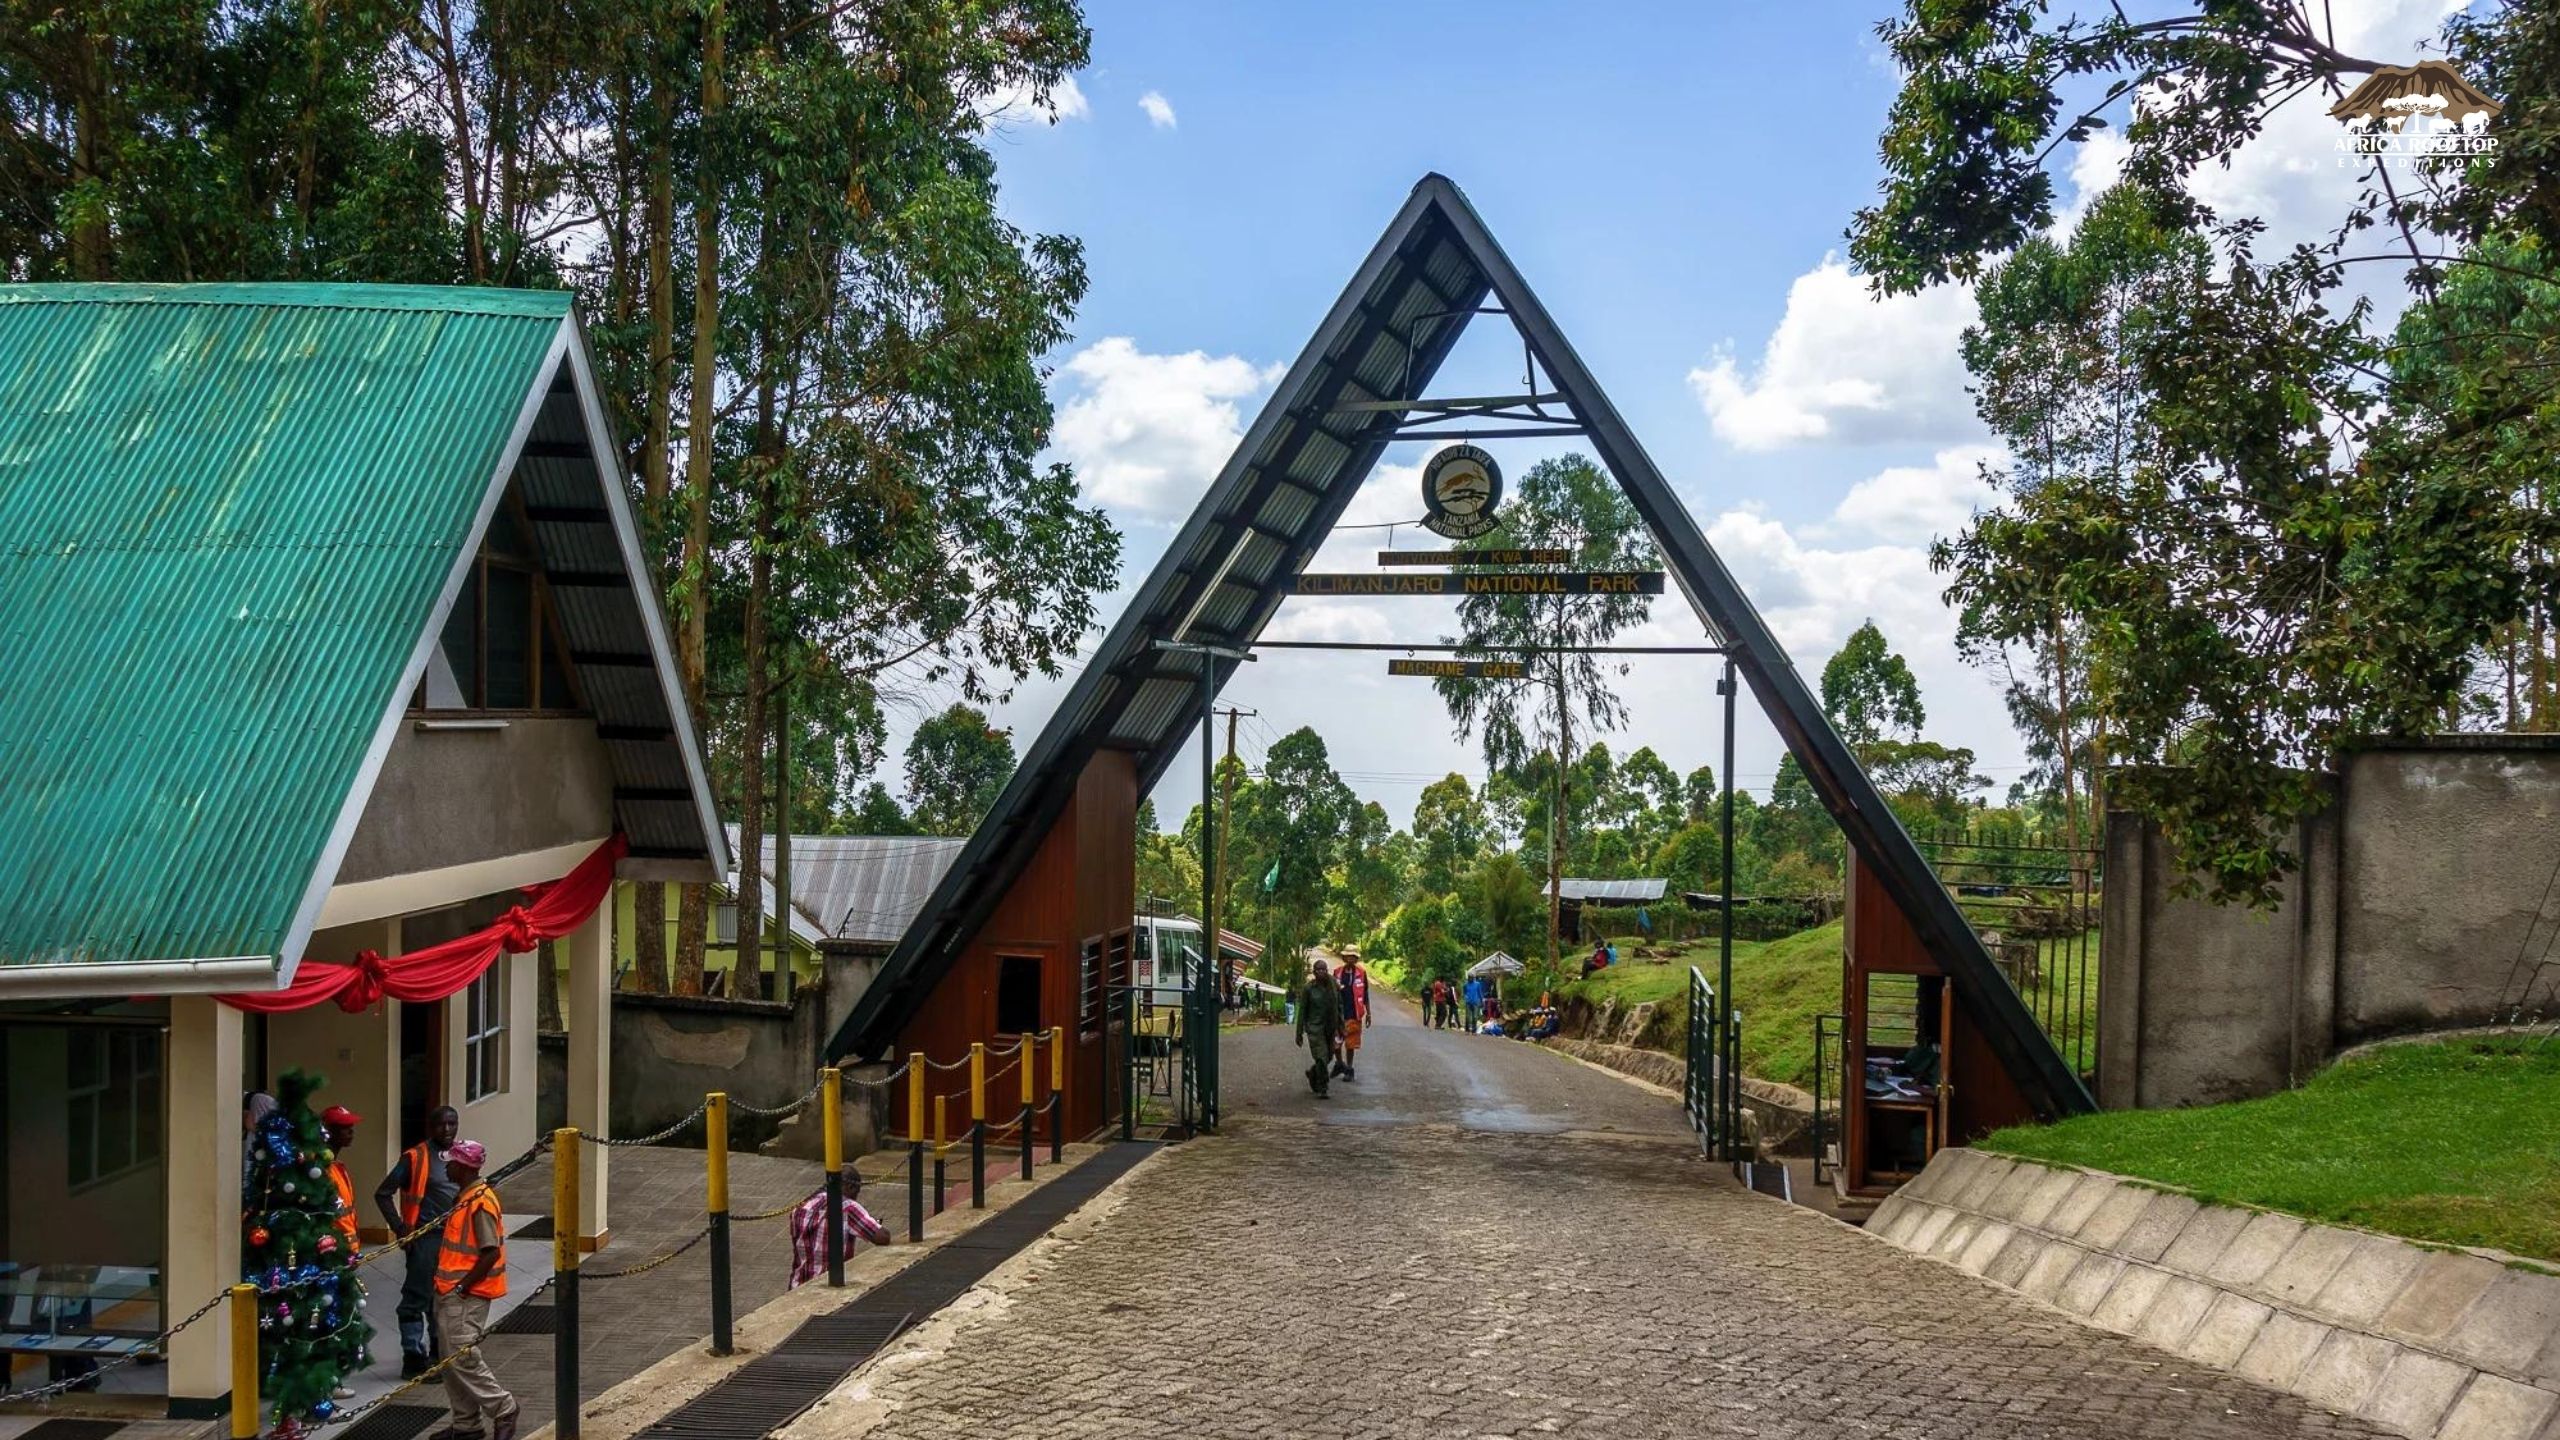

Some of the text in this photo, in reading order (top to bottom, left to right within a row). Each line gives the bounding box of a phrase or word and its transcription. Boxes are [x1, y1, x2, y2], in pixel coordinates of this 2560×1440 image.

[1444, 512, 1480, 526] TANZANIA
[1429, 518, 1493, 536] NATIONAL PARKS
[1491, 551, 1522, 563] KWA
[1532, 550, 1568, 562] HERI
[1297, 576, 1641, 593] KILIMANJARO NATIONAL PARK
[1396, 661, 1520, 676] MACHAME GATE
